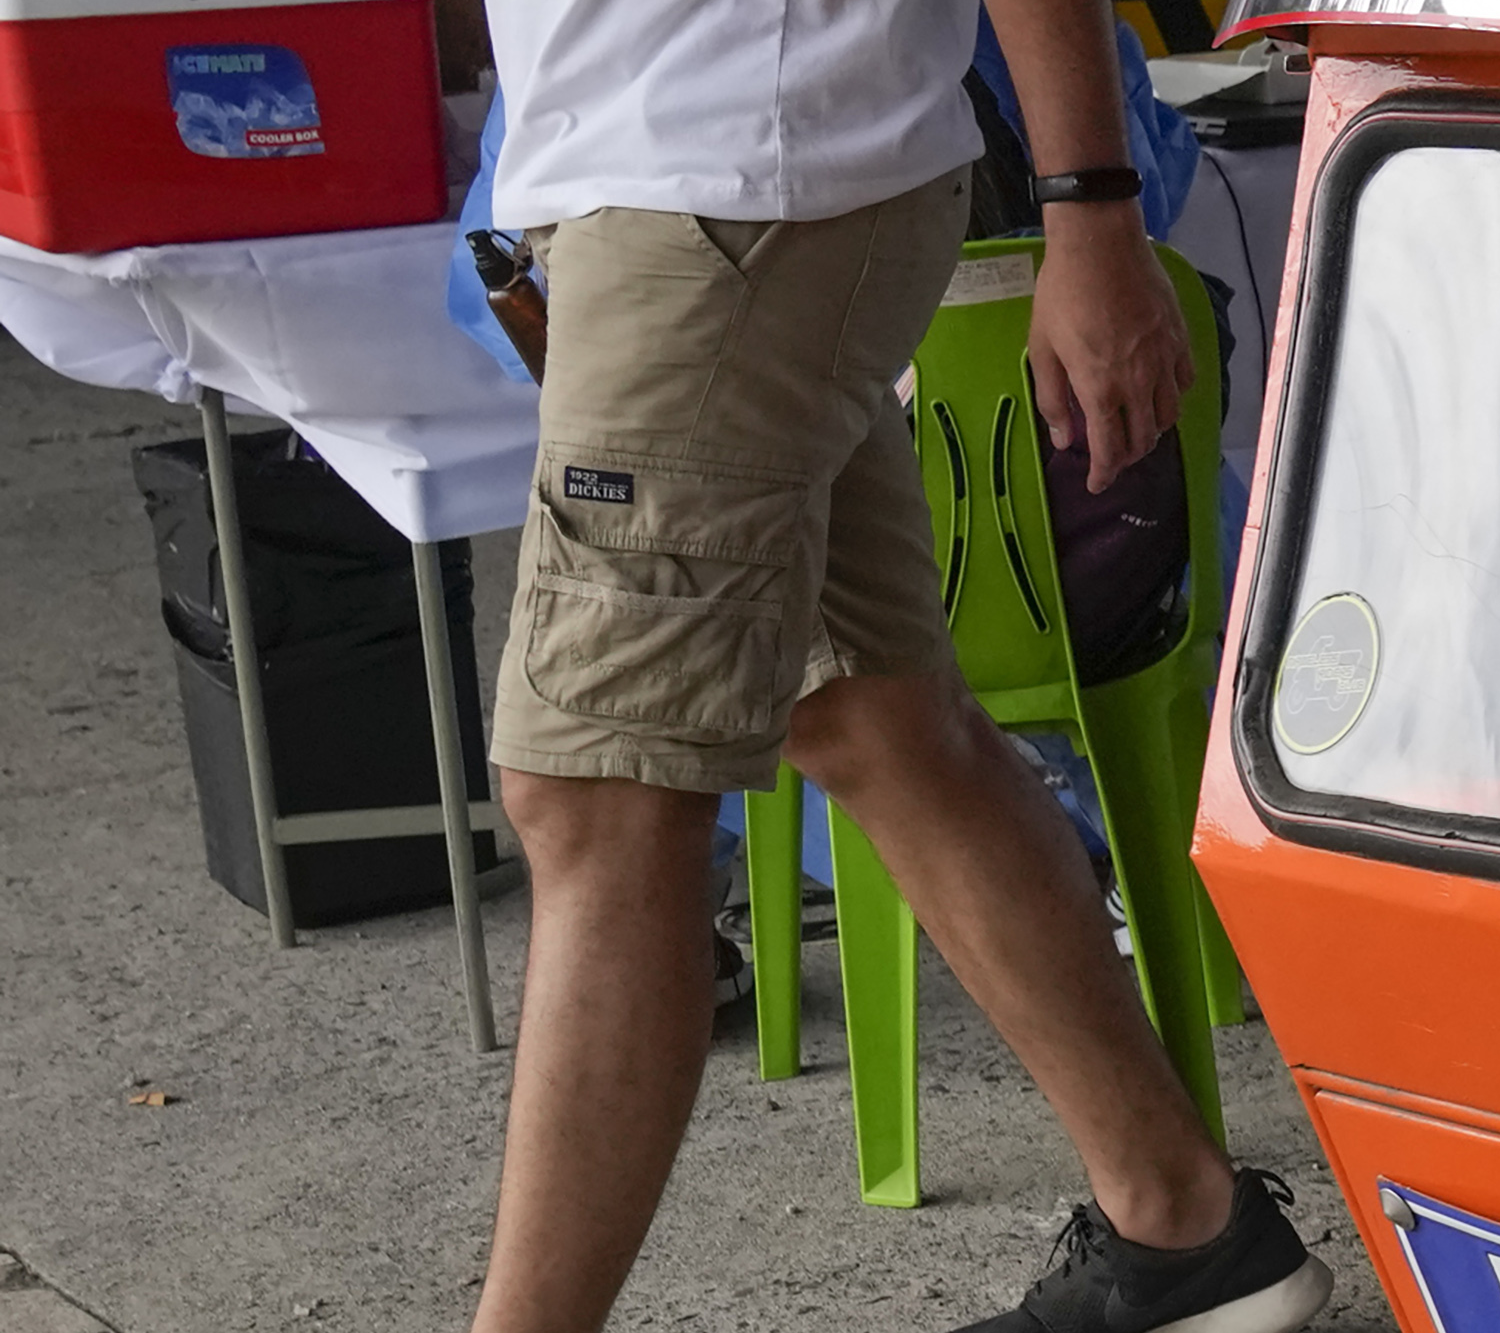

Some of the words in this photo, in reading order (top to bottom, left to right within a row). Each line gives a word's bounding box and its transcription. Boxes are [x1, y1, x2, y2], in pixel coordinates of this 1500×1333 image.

[249, 131, 294, 144] COOLER
[295, 129, 320, 142] BOX
[569, 469, 599, 482] 1922
[568, 482, 627, 500] DICKIES
